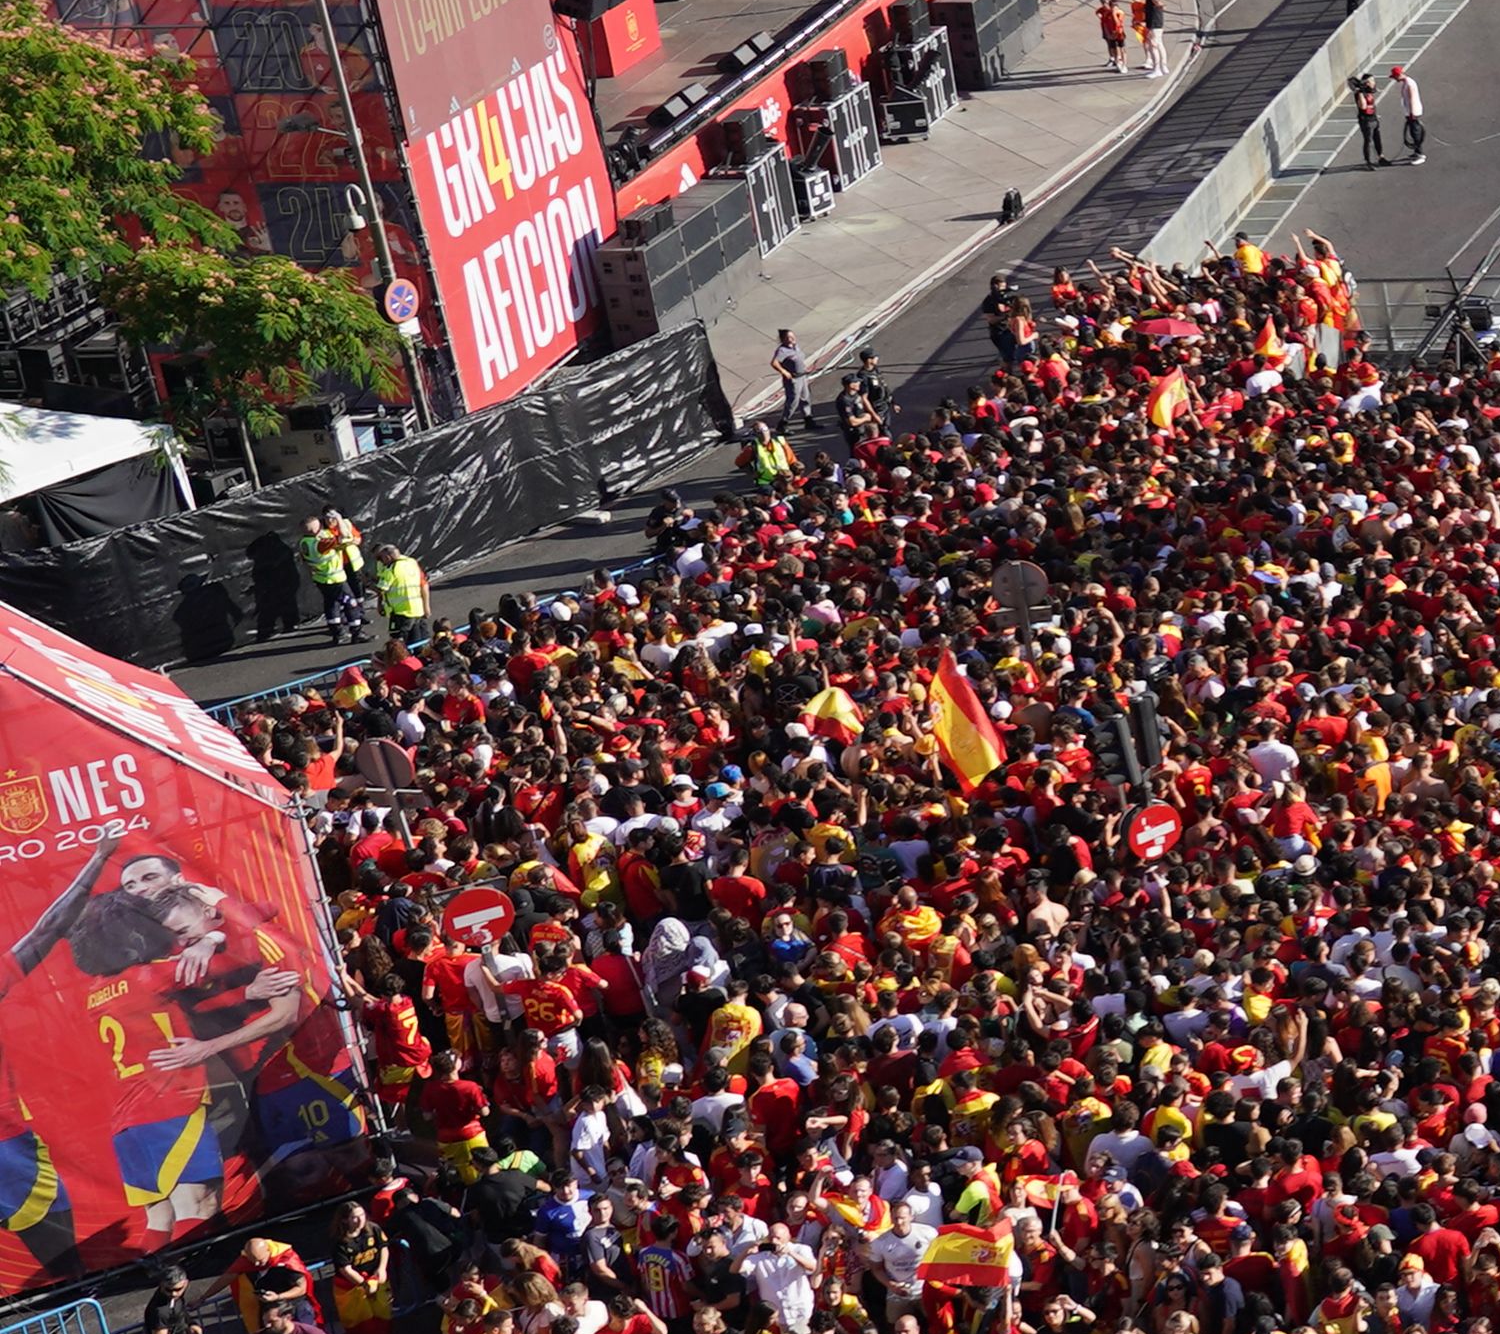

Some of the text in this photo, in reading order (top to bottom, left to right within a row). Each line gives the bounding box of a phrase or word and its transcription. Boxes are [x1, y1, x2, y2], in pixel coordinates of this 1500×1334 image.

[232, 10, 317, 91] 20
[426, 35, 584, 239] GR4CIAS
[463, 176, 603, 392] AFICIÓN
[48, 753, 145, 826] NES
[54, 813, 151, 844] 2024
[298, 1098, 330, 1131] 10
